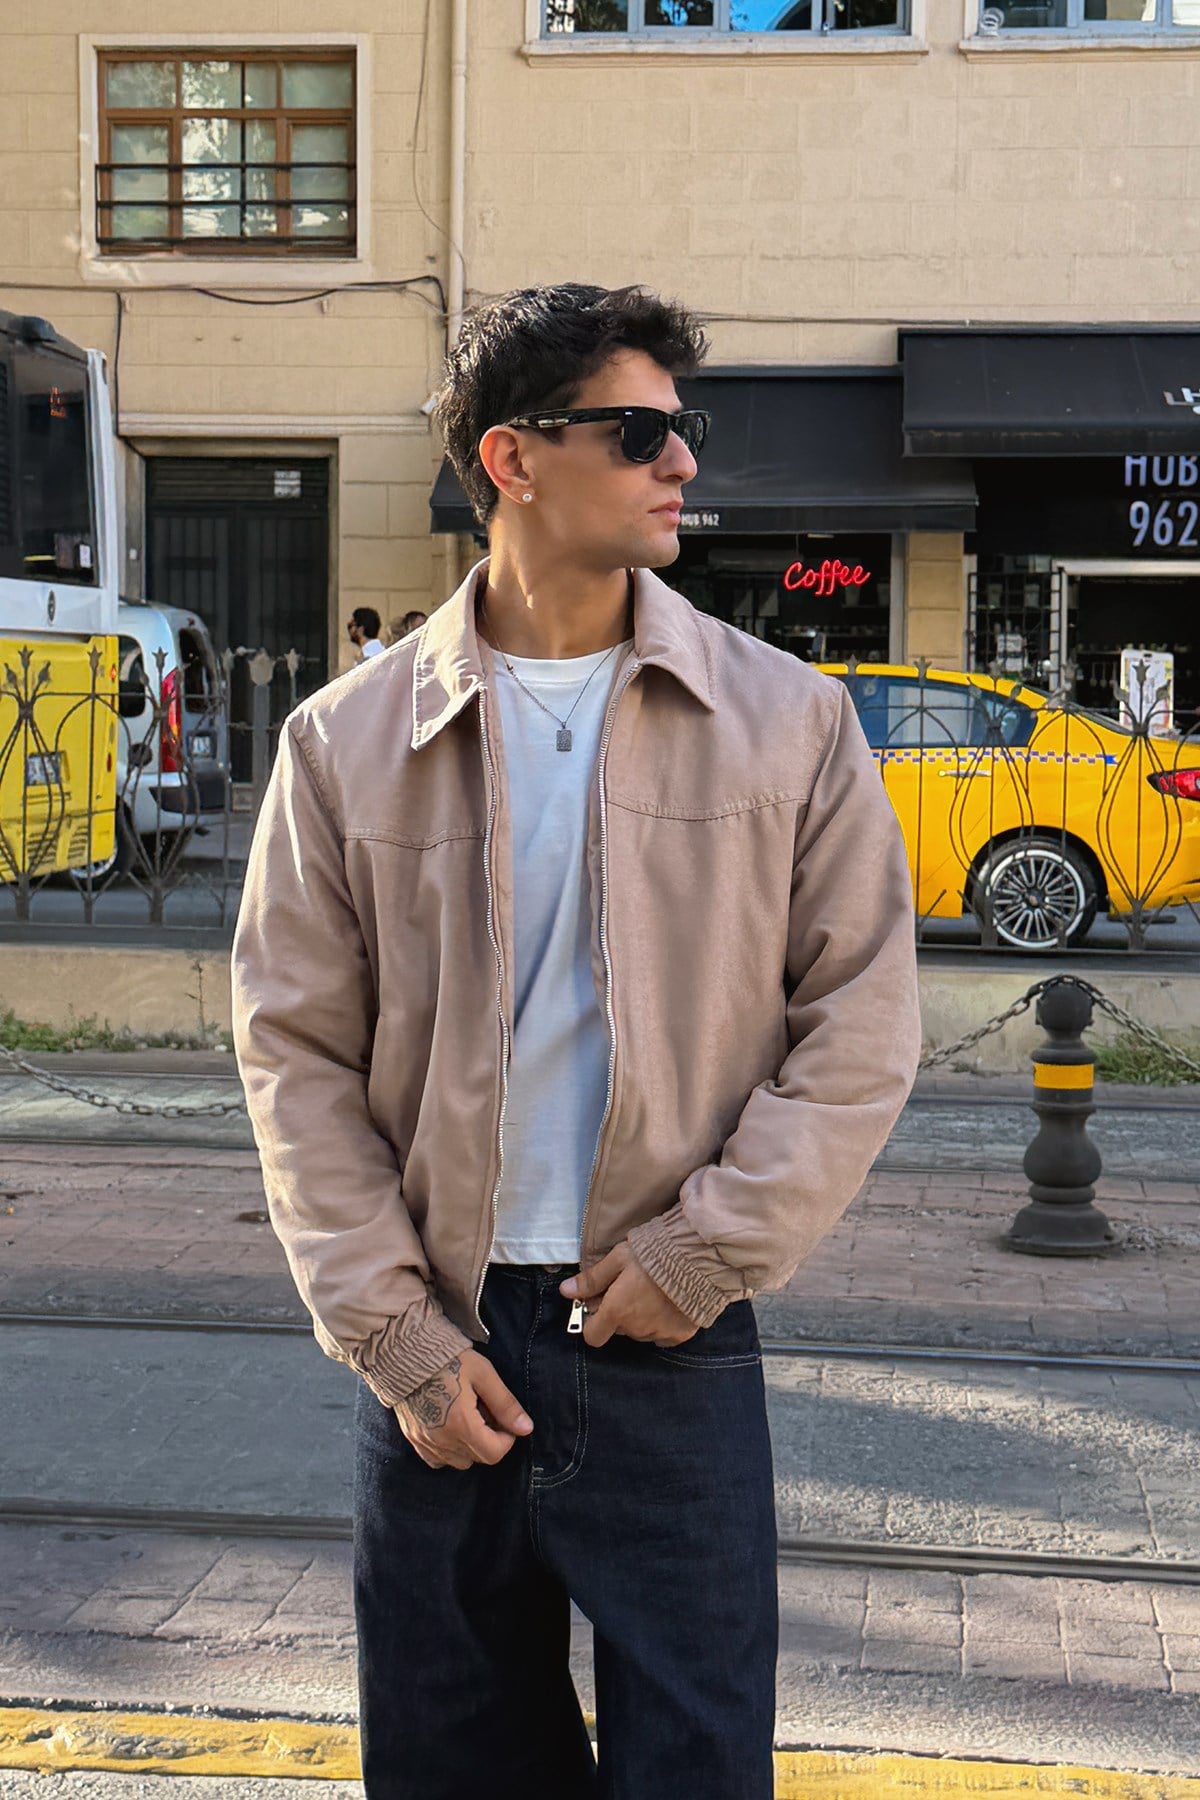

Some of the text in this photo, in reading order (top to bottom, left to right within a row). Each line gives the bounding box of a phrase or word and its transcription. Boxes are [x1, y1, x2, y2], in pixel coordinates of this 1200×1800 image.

[1125, 456, 1199, 486] HUB
[702, 513, 720, 527] 962
[1129, 501, 1199, 546] 962
[784, 559, 871, 596] Coffee
